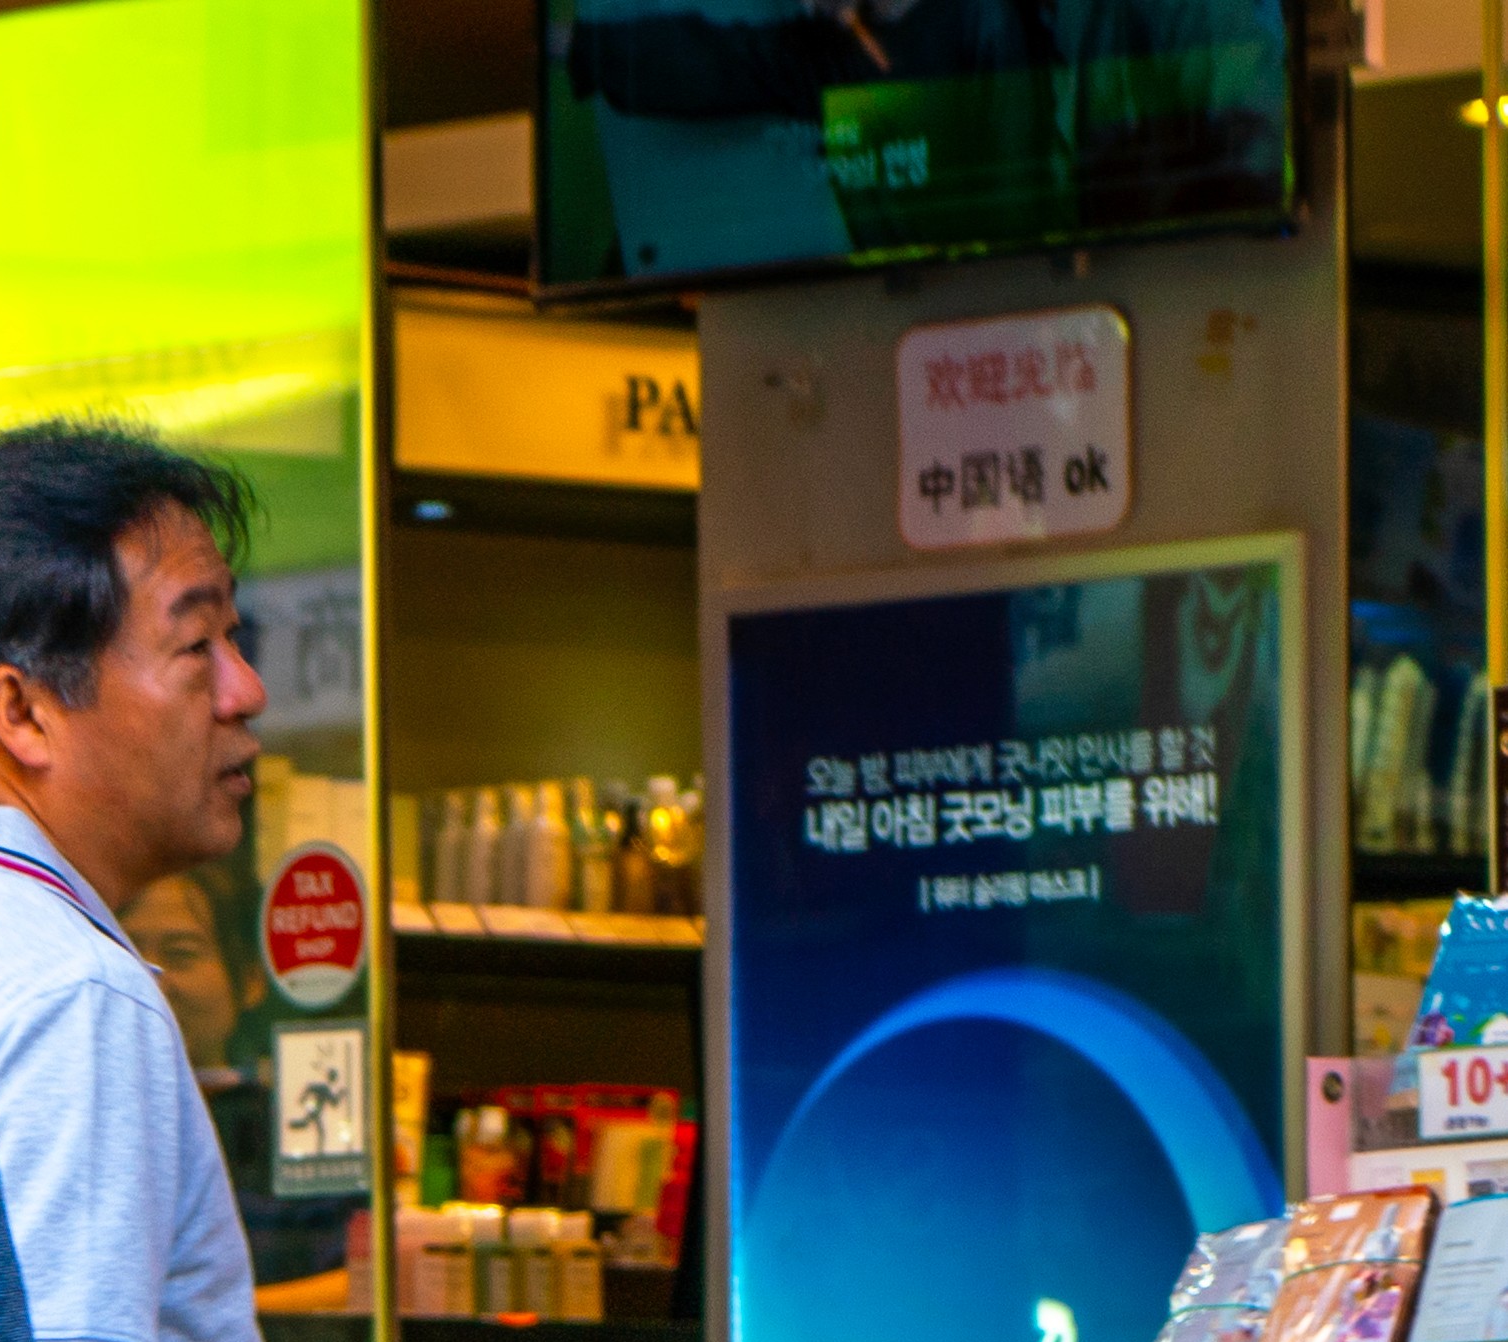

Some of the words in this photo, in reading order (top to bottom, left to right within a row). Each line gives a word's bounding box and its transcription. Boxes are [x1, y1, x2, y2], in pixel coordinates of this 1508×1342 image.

[805, 798, 870, 852] 내일
[873, 792, 937, 848] 아침
[940, 787, 1034, 842] 굿모닝
[1040, 778, 1135, 833] 피부를
[292, 870, 335, 898] TAX
[272, 902, 358, 934] REFUND
